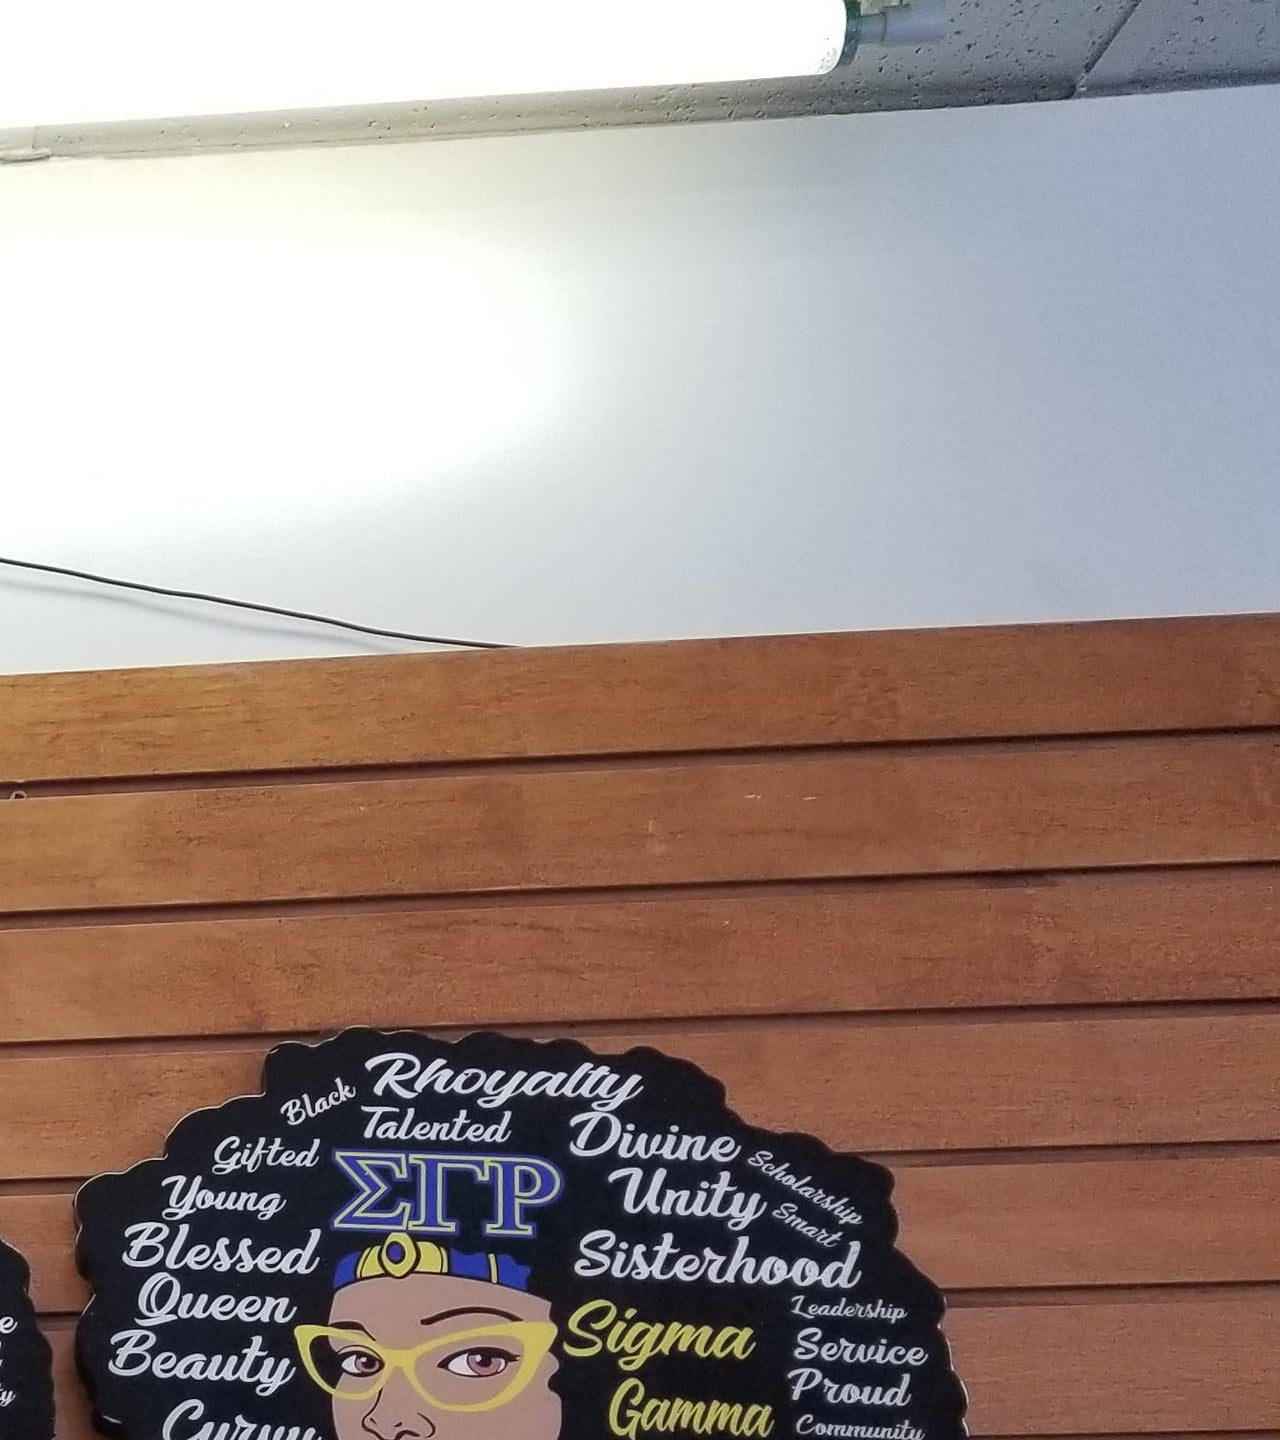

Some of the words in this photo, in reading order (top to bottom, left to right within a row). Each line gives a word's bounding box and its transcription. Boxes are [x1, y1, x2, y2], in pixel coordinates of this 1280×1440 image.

[281, 1077, 355, 1125] Black
[365, 1053, 644, 1110] Rhoyalty
[361, 1106, 511, 1142] Talented
[570, 1110, 741, 1162] Divine
[212, 1136, 320, 1174] Gifted
[162, 1175, 286, 1220] Young
[608, 1168, 767, 1230] Unity
[748, 1151, 862, 1224] Scholarship
[122, 1222, 321, 1274] Blessed
[772, 1203, 843, 1247] Smart
[574, 1230, 861, 1288] Sisterhood
[135, 1272, 297, 1326] Queen
[791, 1295, 907, 1323] Leadership
[563, 1300, 756, 1371] Sigma
[794, 1328, 928, 1365] Service
[109, 1330, 296, 1396] Beauty
[788, 1368, 911, 1406] Proud
[609, 1378, 774, 1440] Gamma
